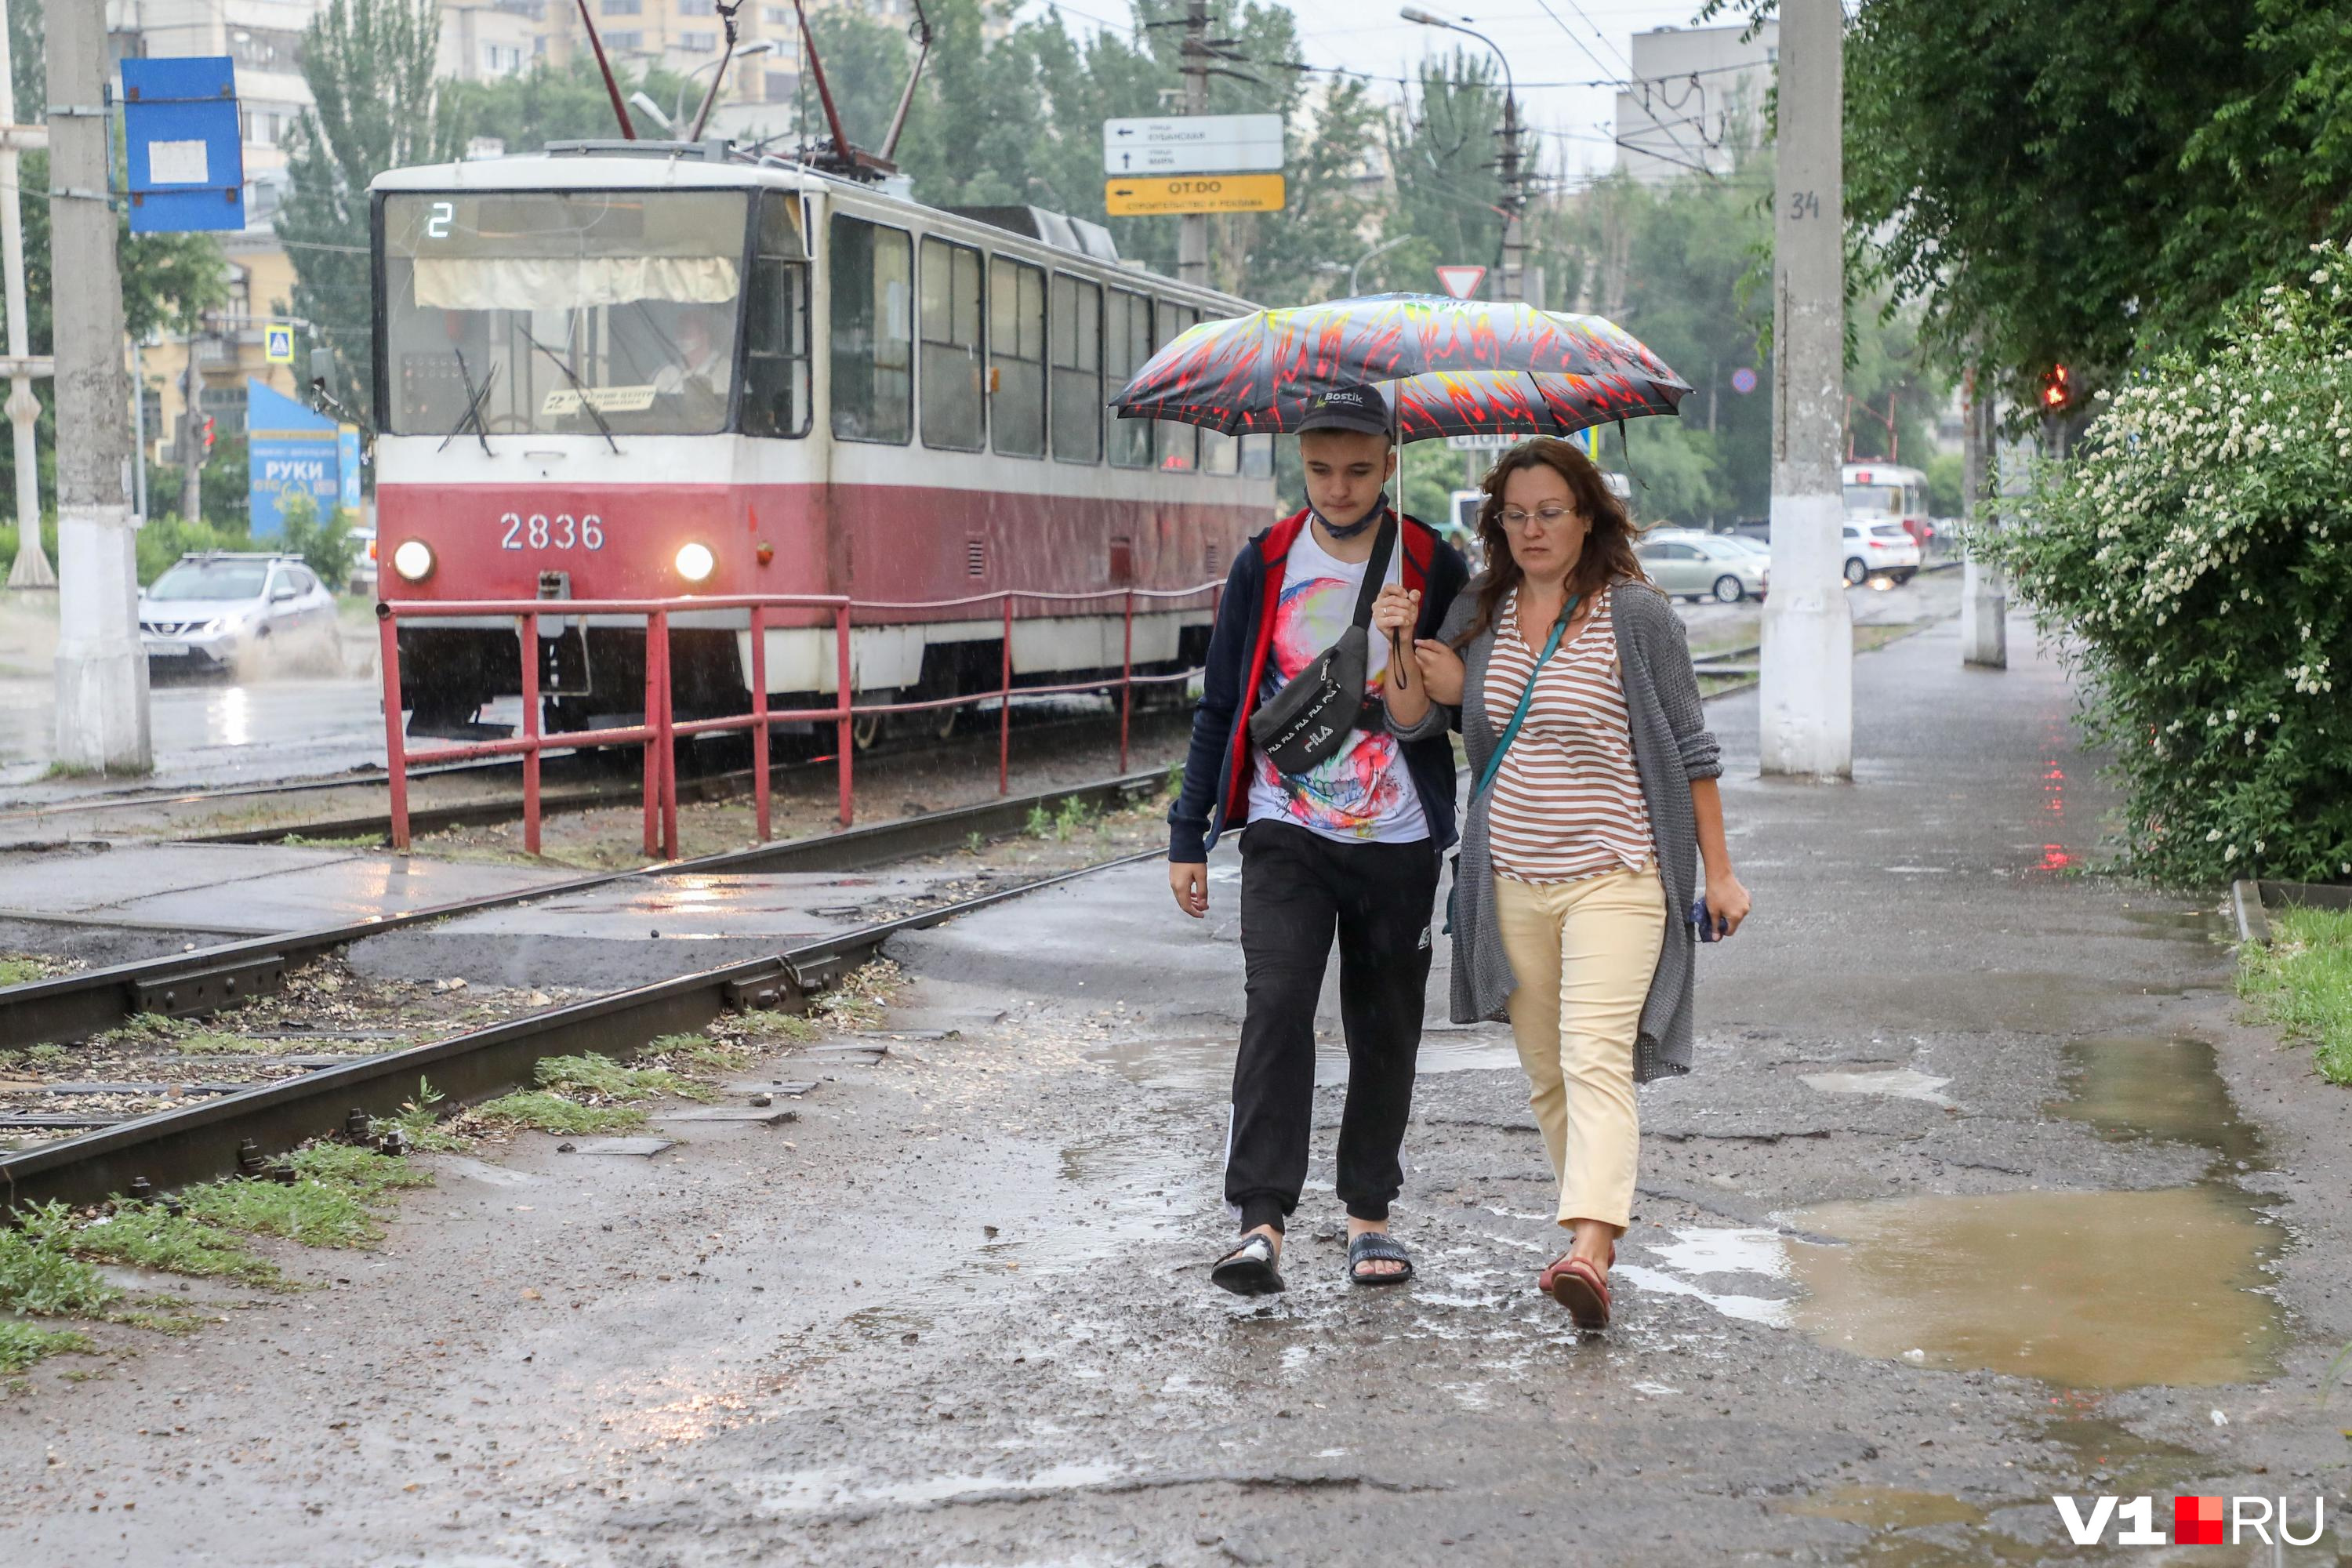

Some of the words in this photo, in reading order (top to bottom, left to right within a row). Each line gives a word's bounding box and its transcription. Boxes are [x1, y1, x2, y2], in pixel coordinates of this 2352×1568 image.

[429, 202, 452, 238] 2
[1791, 191, 1819, 220] 34
[1324, 393, 1363, 403] Bostik
[266, 460, 323, 481] РУКИ
[501, 512, 604, 550] 2836
[1268, 743, 1282, 753] FILA
[1281, 732, 1295, 743] FILA
[1295, 719, 1309, 731] FILA
[1308, 705, 1323, 718] FILA
[1304, 725, 1334, 753] FILA
